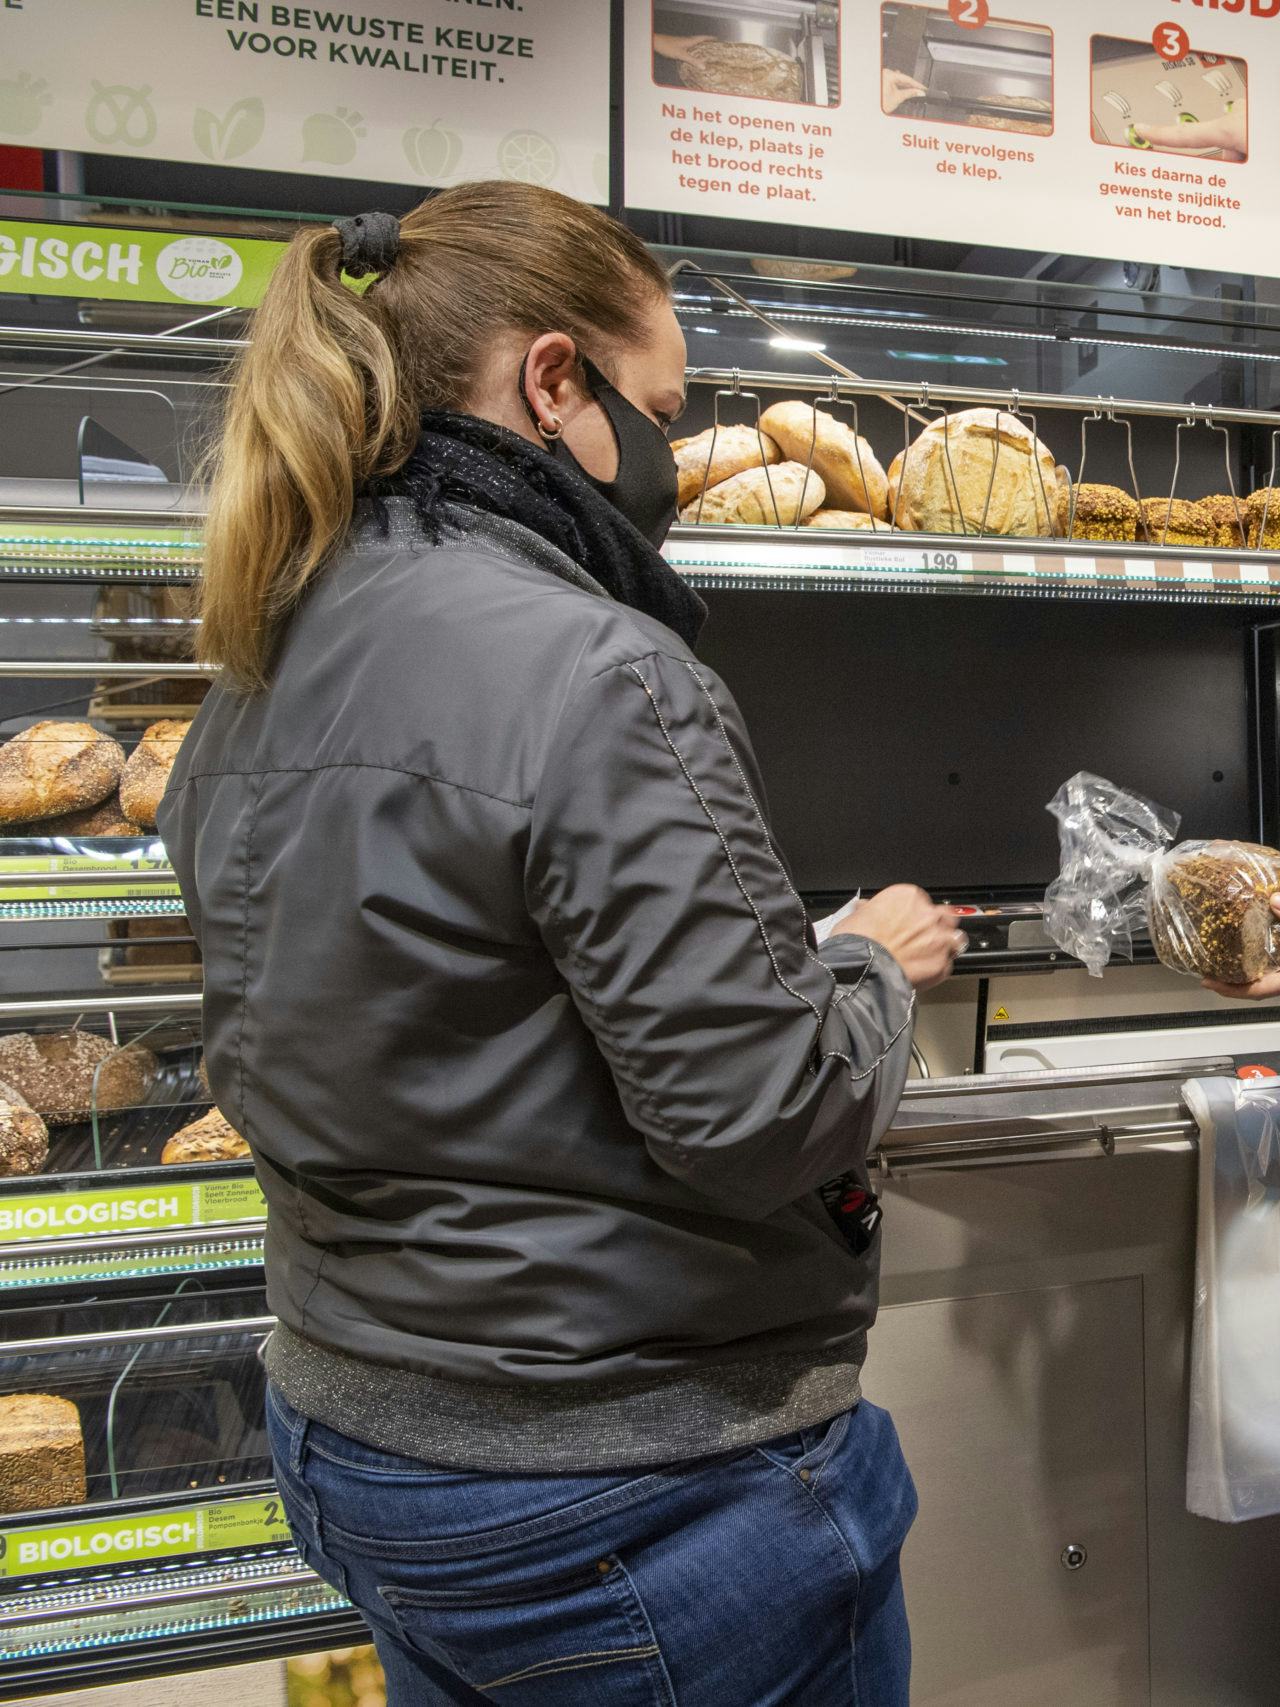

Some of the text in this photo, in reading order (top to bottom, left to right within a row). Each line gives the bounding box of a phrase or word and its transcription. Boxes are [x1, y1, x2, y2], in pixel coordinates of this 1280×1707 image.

[958, 0, 979, 24] 2
[195, 0, 535, 59] EEN BEWUSTE KEUZE
[1162, 28, 1180, 57] 3
[227, 29, 505, 83] VOOR KWALITEIT.
[661, 103, 832, 137] Na het openen van
[670, 127, 825, 159] de klep, plaats je
[902, 134, 1035, 162] Sluit vervolgens
[672, 149, 823, 180] het brood rechts
[936, 160, 1002, 181] de klep.
[1114, 162, 1227, 188] Kies daarna de
[679, 174, 817, 202] tegen de plaat.
[1099, 182, 1241, 210] gewenste snijdikte
[1115, 205, 1227, 229] van het brood.
[0, 1197, 179, 1231] BIOLOGISCH
[208, 1508, 222, 1516] Bio
[208, 1514, 236, 1523] Desem
